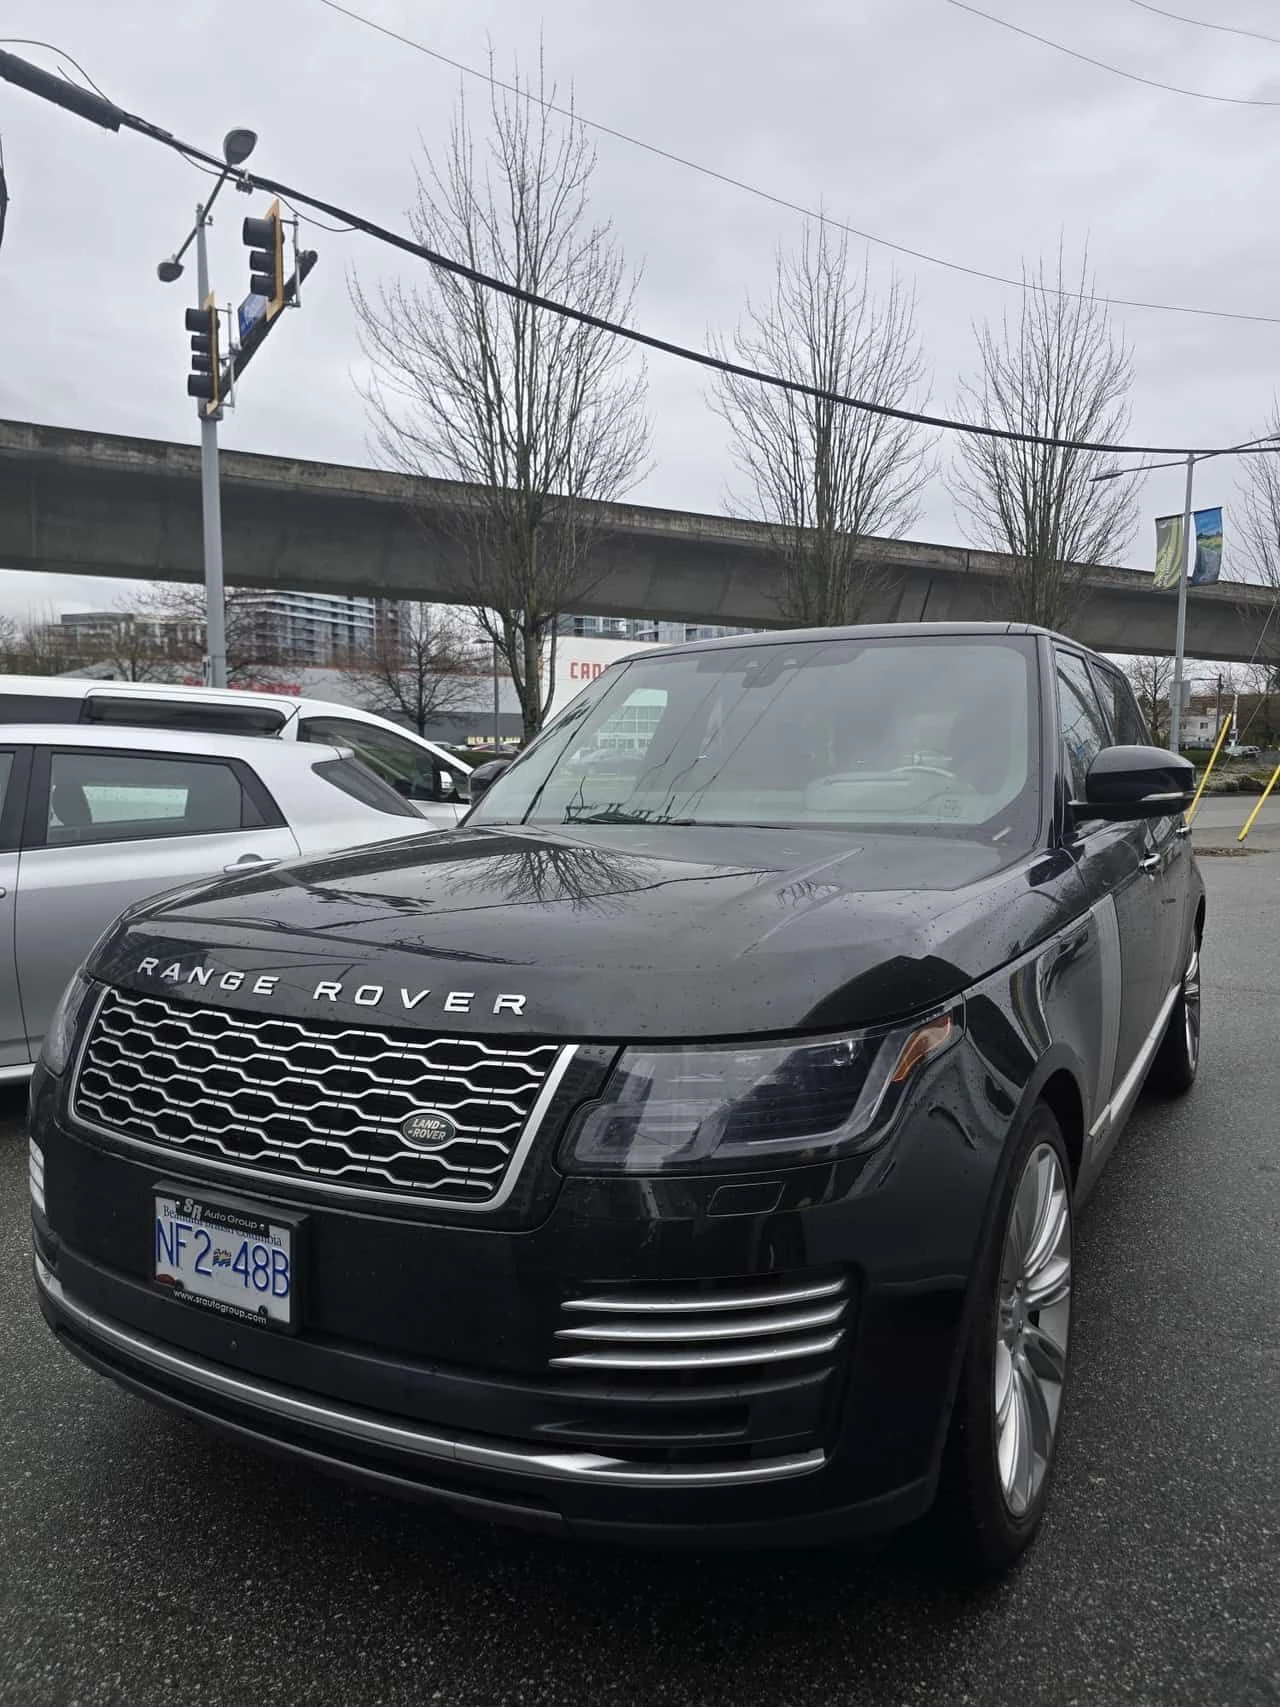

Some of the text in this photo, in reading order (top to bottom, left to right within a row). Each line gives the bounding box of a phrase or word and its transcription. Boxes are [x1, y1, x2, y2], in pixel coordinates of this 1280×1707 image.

[137, 957, 527, 1015] RANGE ROVER
[412, 1118, 441, 1130] LAND
[412, 1128, 446, 1141] ROVER
[204, 1209, 226, 1222] Auto
[227, 1214, 258, 1230] Group
[156, 1216, 212, 1276] NF2
[232, 1240, 290, 1298] 48B
[173, 1289, 267, 1325] www.srautogroup.com
